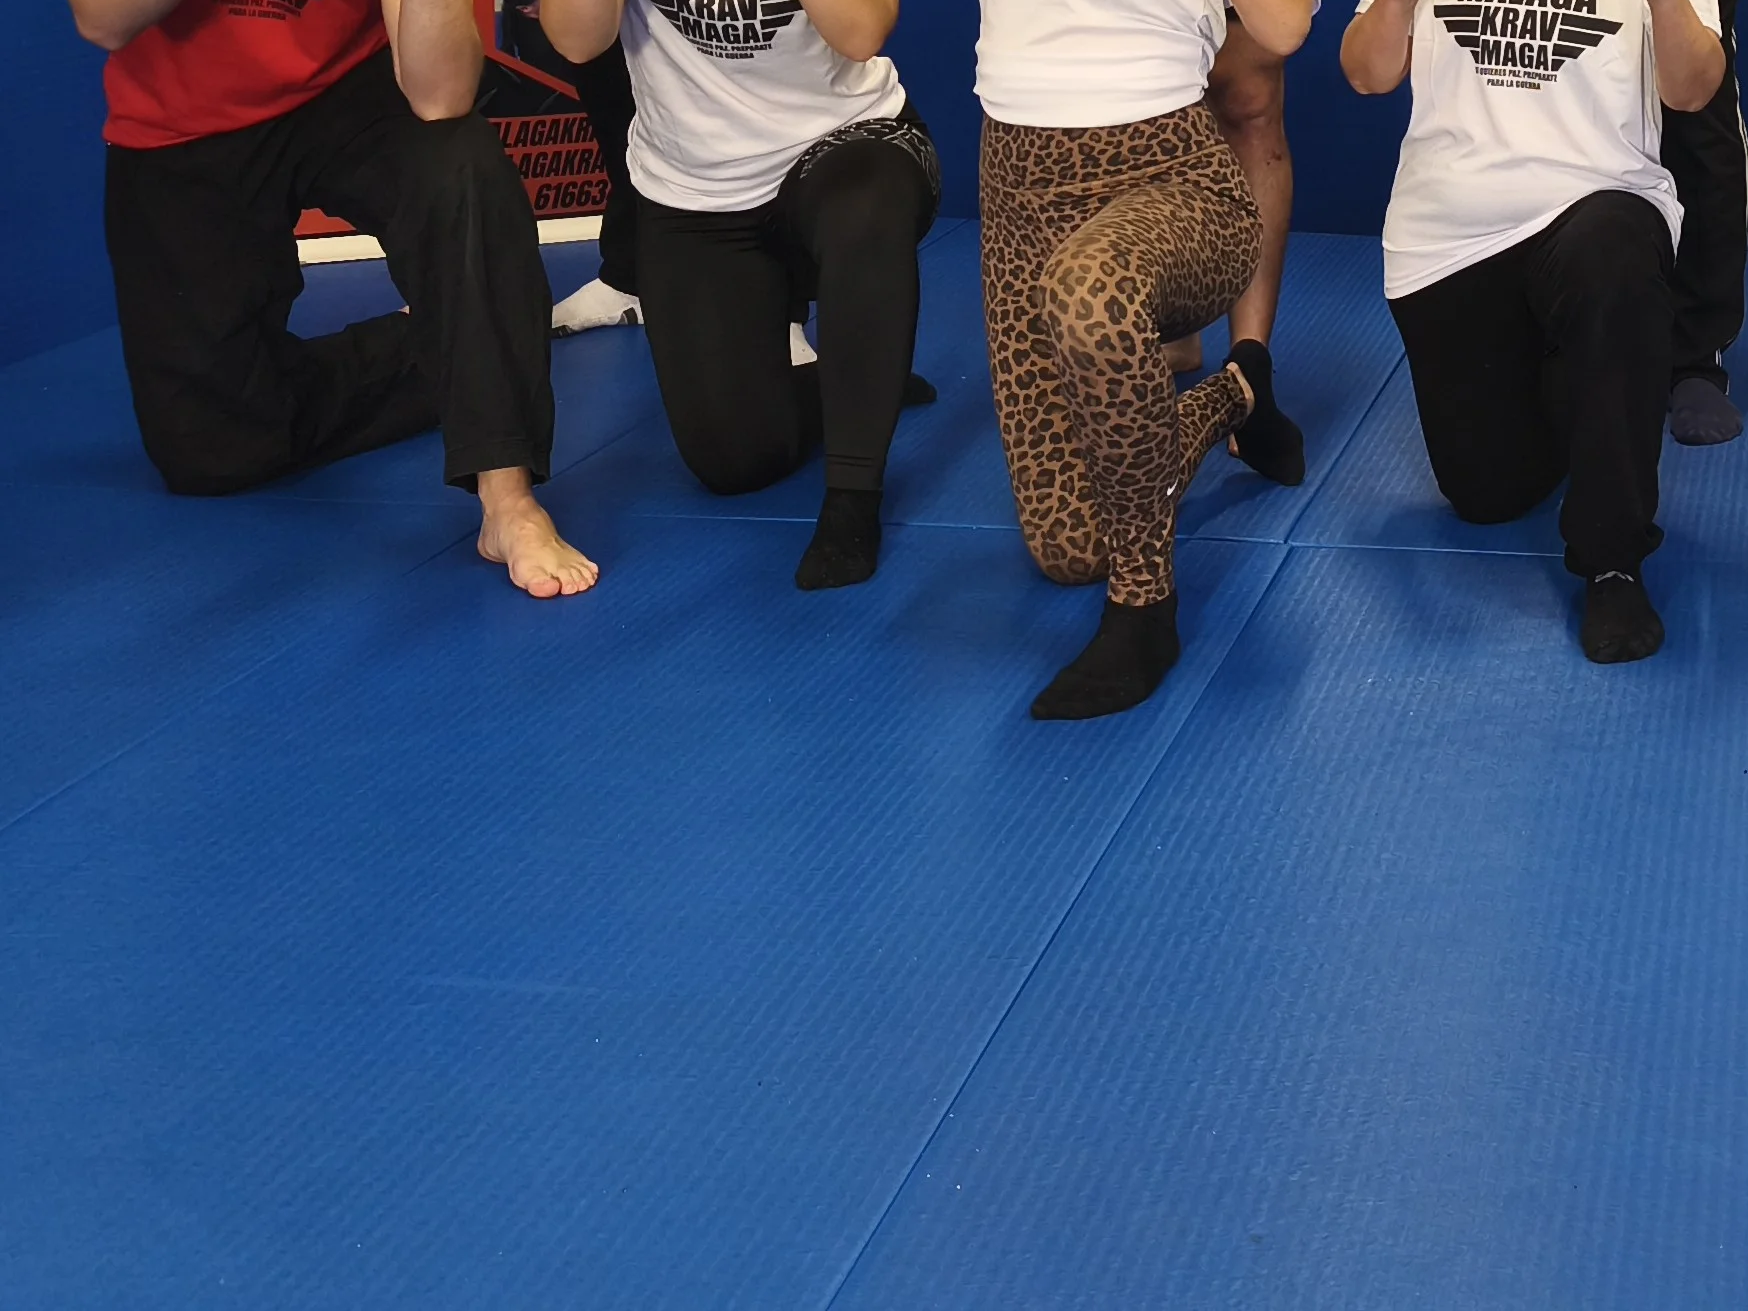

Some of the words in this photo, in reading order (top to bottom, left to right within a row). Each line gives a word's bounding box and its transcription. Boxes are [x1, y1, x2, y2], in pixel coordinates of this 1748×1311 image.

[681, 15, 762, 44] MAGA
[1480, 6, 1561, 42] KRAV
[1480, 39, 1549, 71] MAGA
[533, 179, 612, 211] 61663
